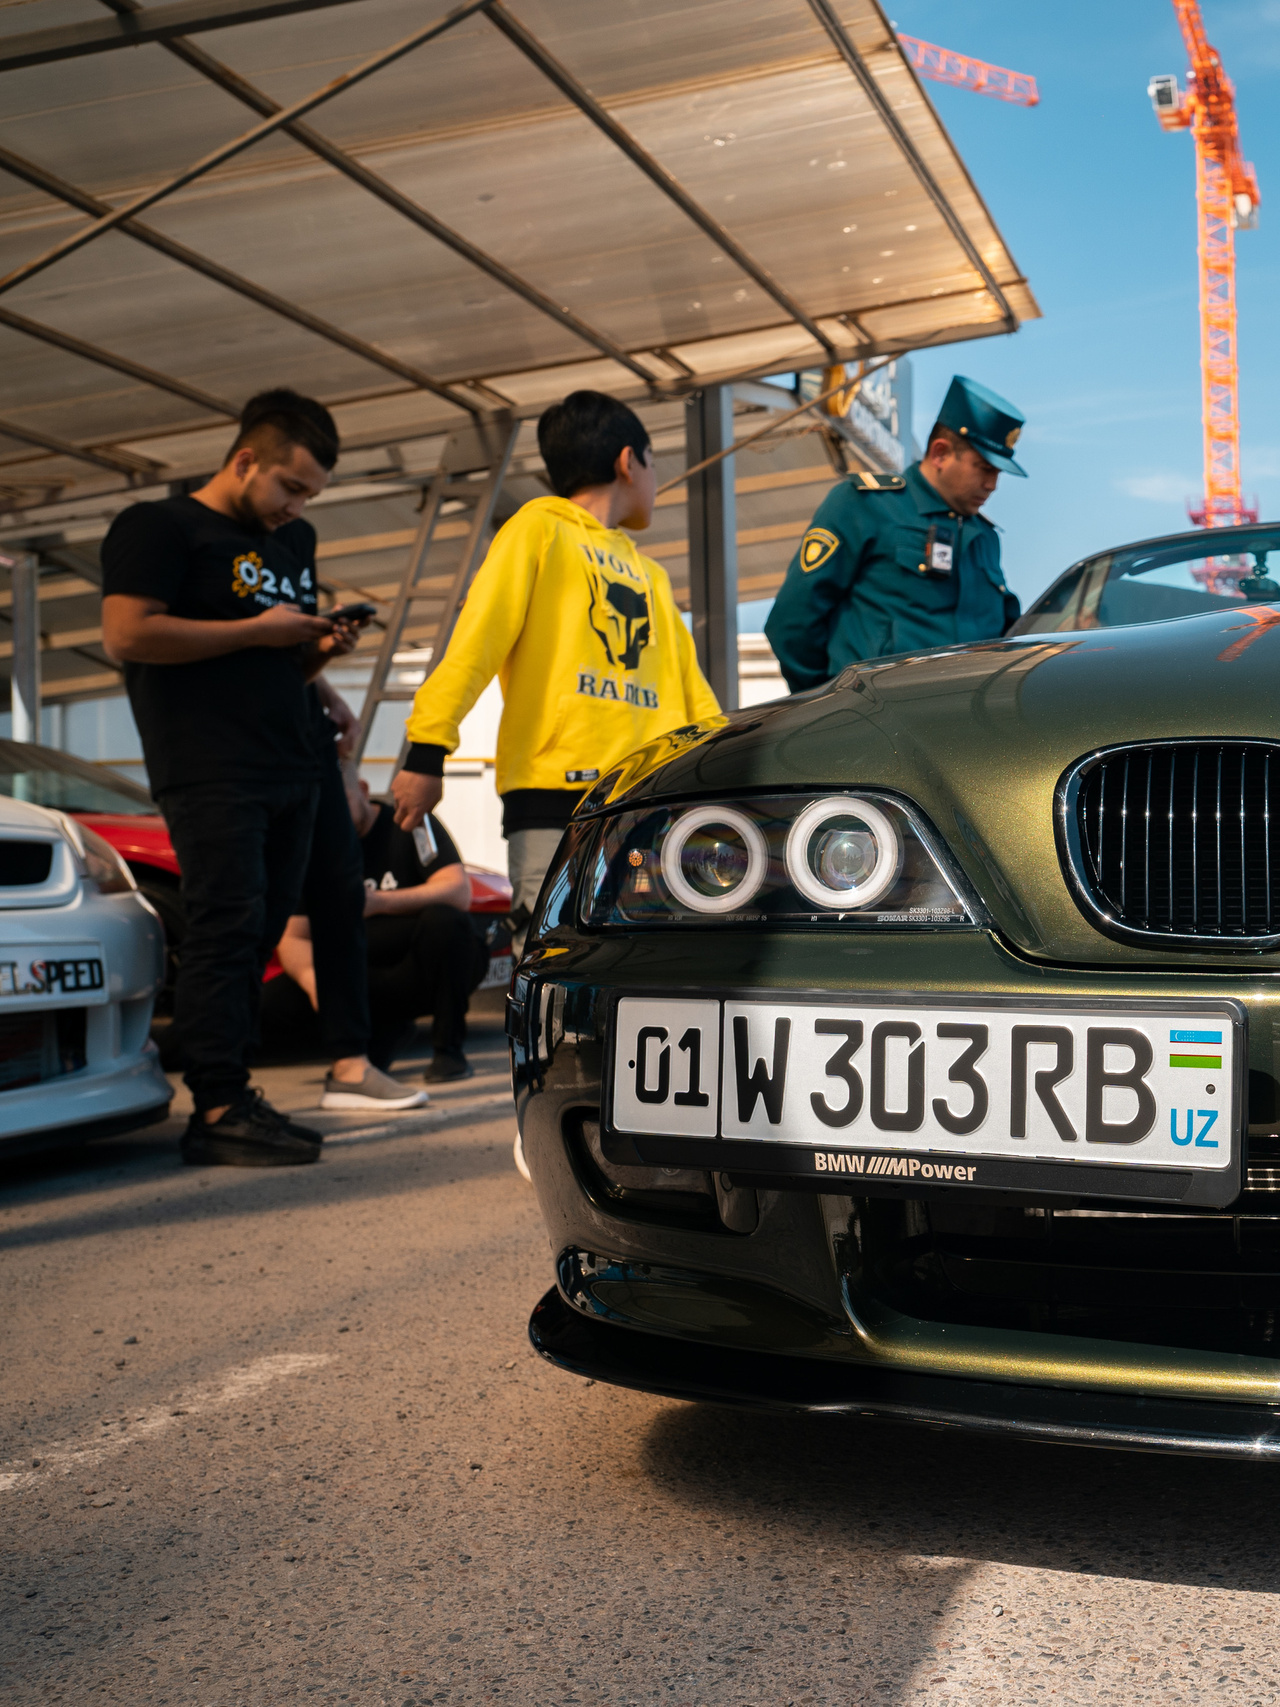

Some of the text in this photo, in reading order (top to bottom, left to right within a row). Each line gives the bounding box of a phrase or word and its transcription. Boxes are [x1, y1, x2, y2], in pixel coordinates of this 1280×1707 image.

[634, 1015, 1158, 1144] 01 W 303 RB
[1169, 1107, 1220, 1149] UZ
